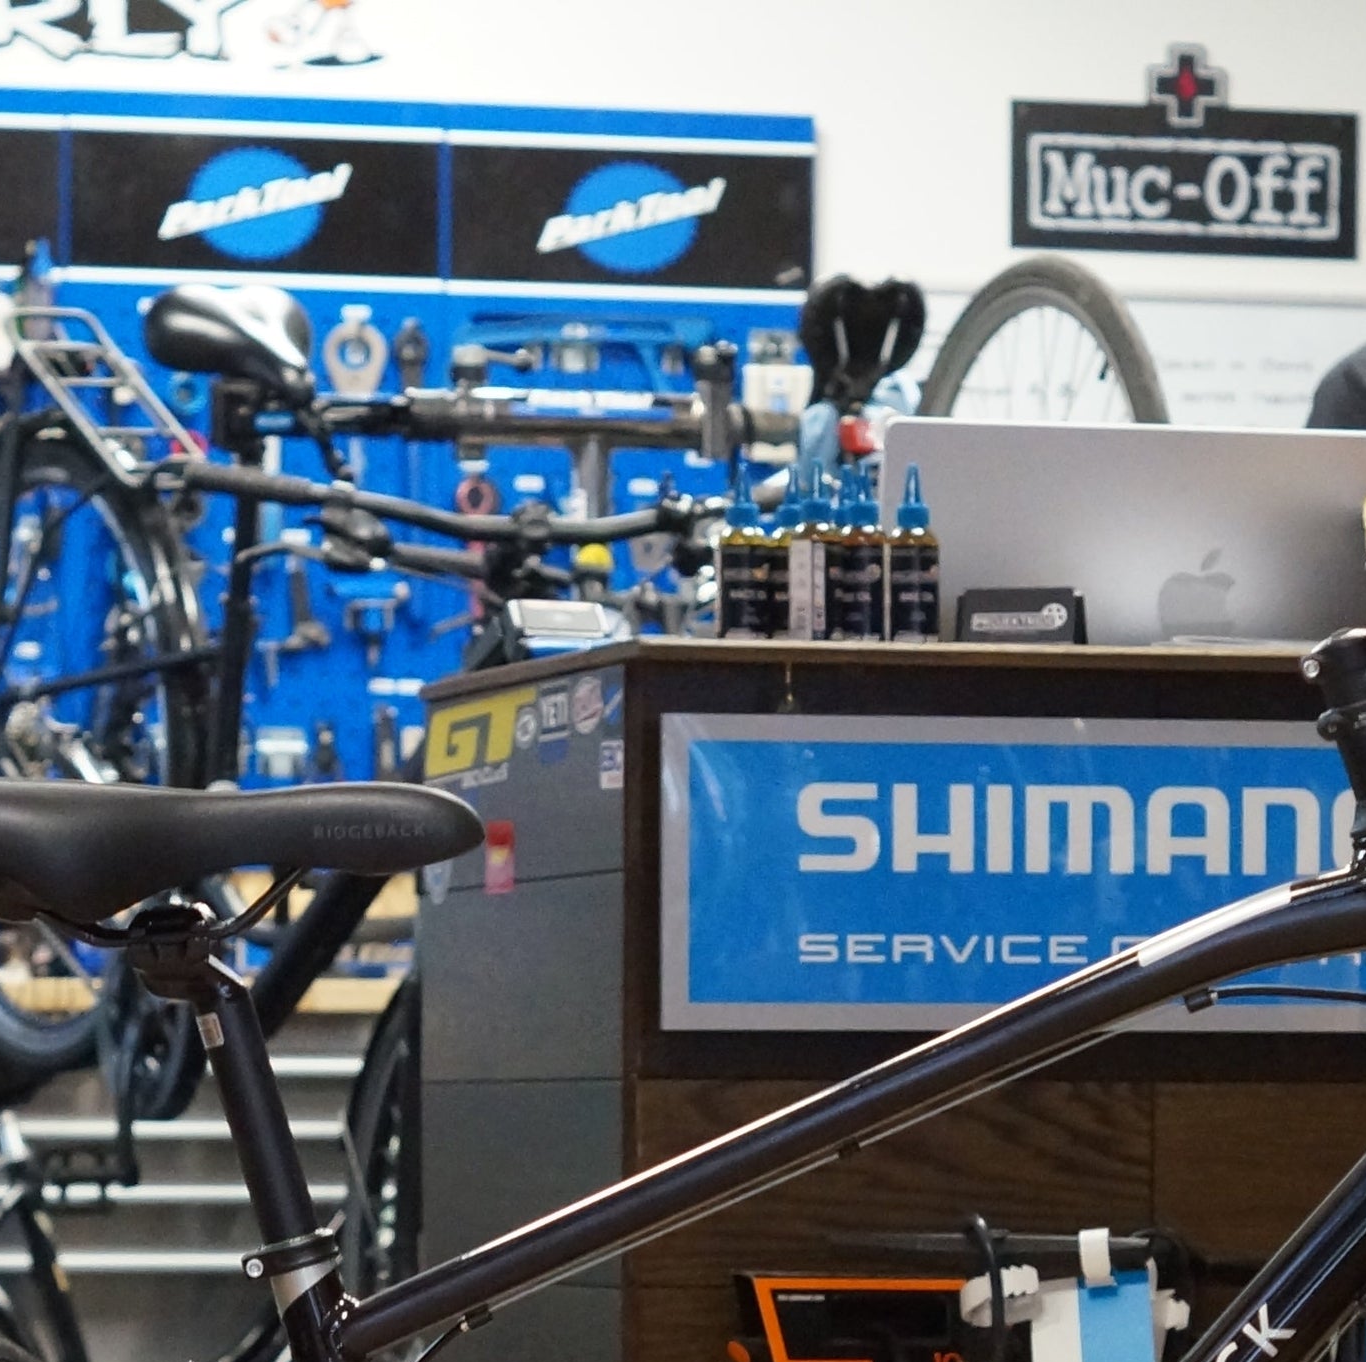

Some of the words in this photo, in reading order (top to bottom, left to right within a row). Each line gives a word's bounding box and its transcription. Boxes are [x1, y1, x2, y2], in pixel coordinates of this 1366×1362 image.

[1043, 152, 1325, 226] Muc-Off
[424, 686, 537, 779] GT
[312, 822, 427, 841] RIDGEBACK
[798, 934, 1088, 967] SERVICE
